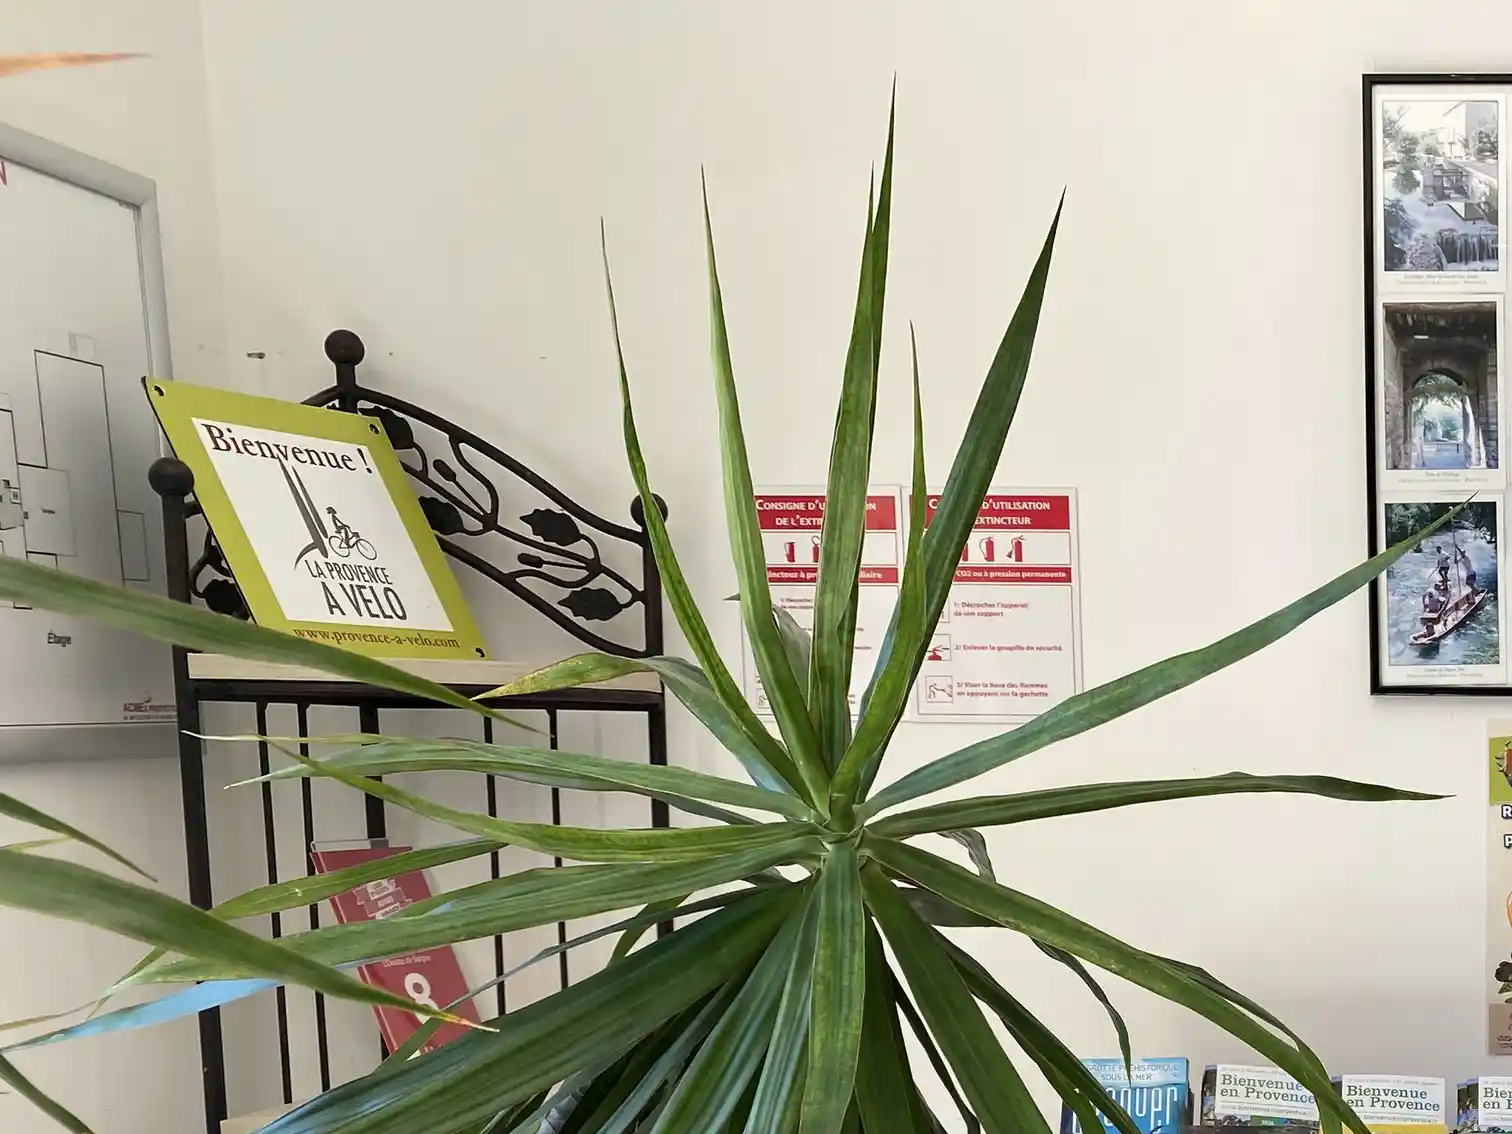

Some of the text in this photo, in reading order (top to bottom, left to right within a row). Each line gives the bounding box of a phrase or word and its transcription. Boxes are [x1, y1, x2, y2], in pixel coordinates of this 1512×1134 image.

[200, 423, 373, 474] Bienvenue !
[305, 560, 393, 586] LA PROVENCE
[321, 582, 407, 621] A VELO
[292, 627, 460, 649] www.provence-a-velo.com
[1347, 1085, 1427, 1100] Bienvenue
[1483, 1100, 1500, 1110] en
